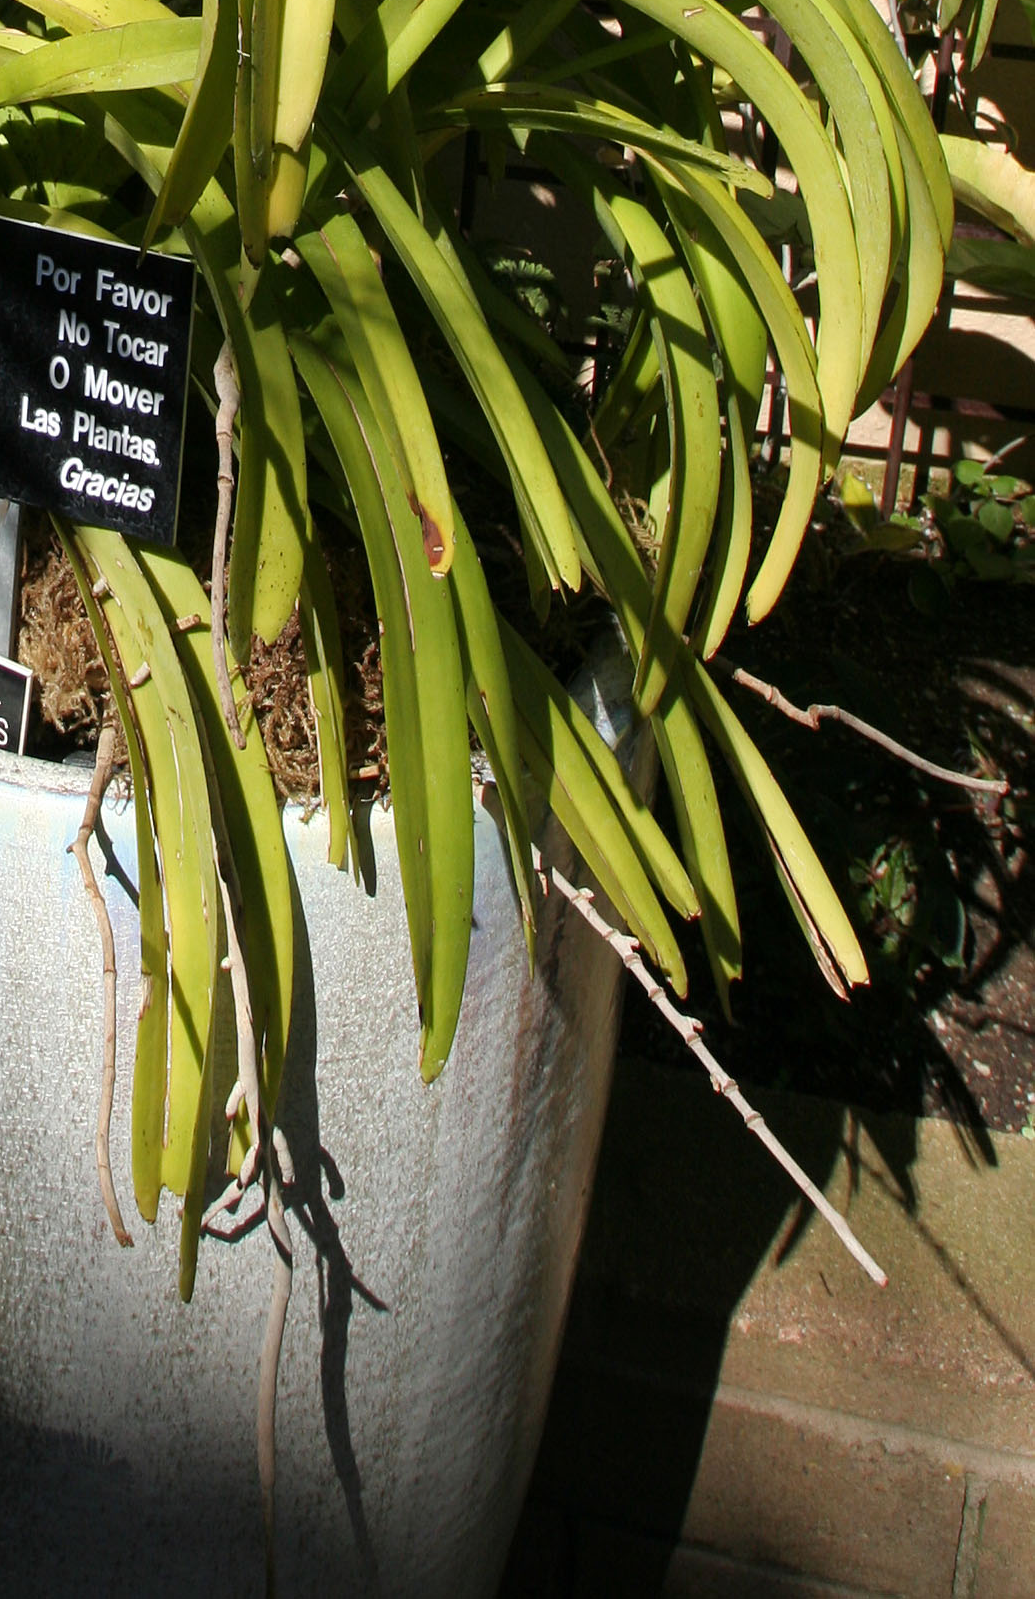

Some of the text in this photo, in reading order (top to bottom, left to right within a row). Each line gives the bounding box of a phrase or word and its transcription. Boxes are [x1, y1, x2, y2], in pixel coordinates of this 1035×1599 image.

[36, 254, 172, 318] Por Favor
[58, 309, 169, 367] No Tocar
[49, 355, 164, 416] O Mover
[20, 395, 161, 466] Las Plantas.
[59, 457, 156, 513] Gracias
